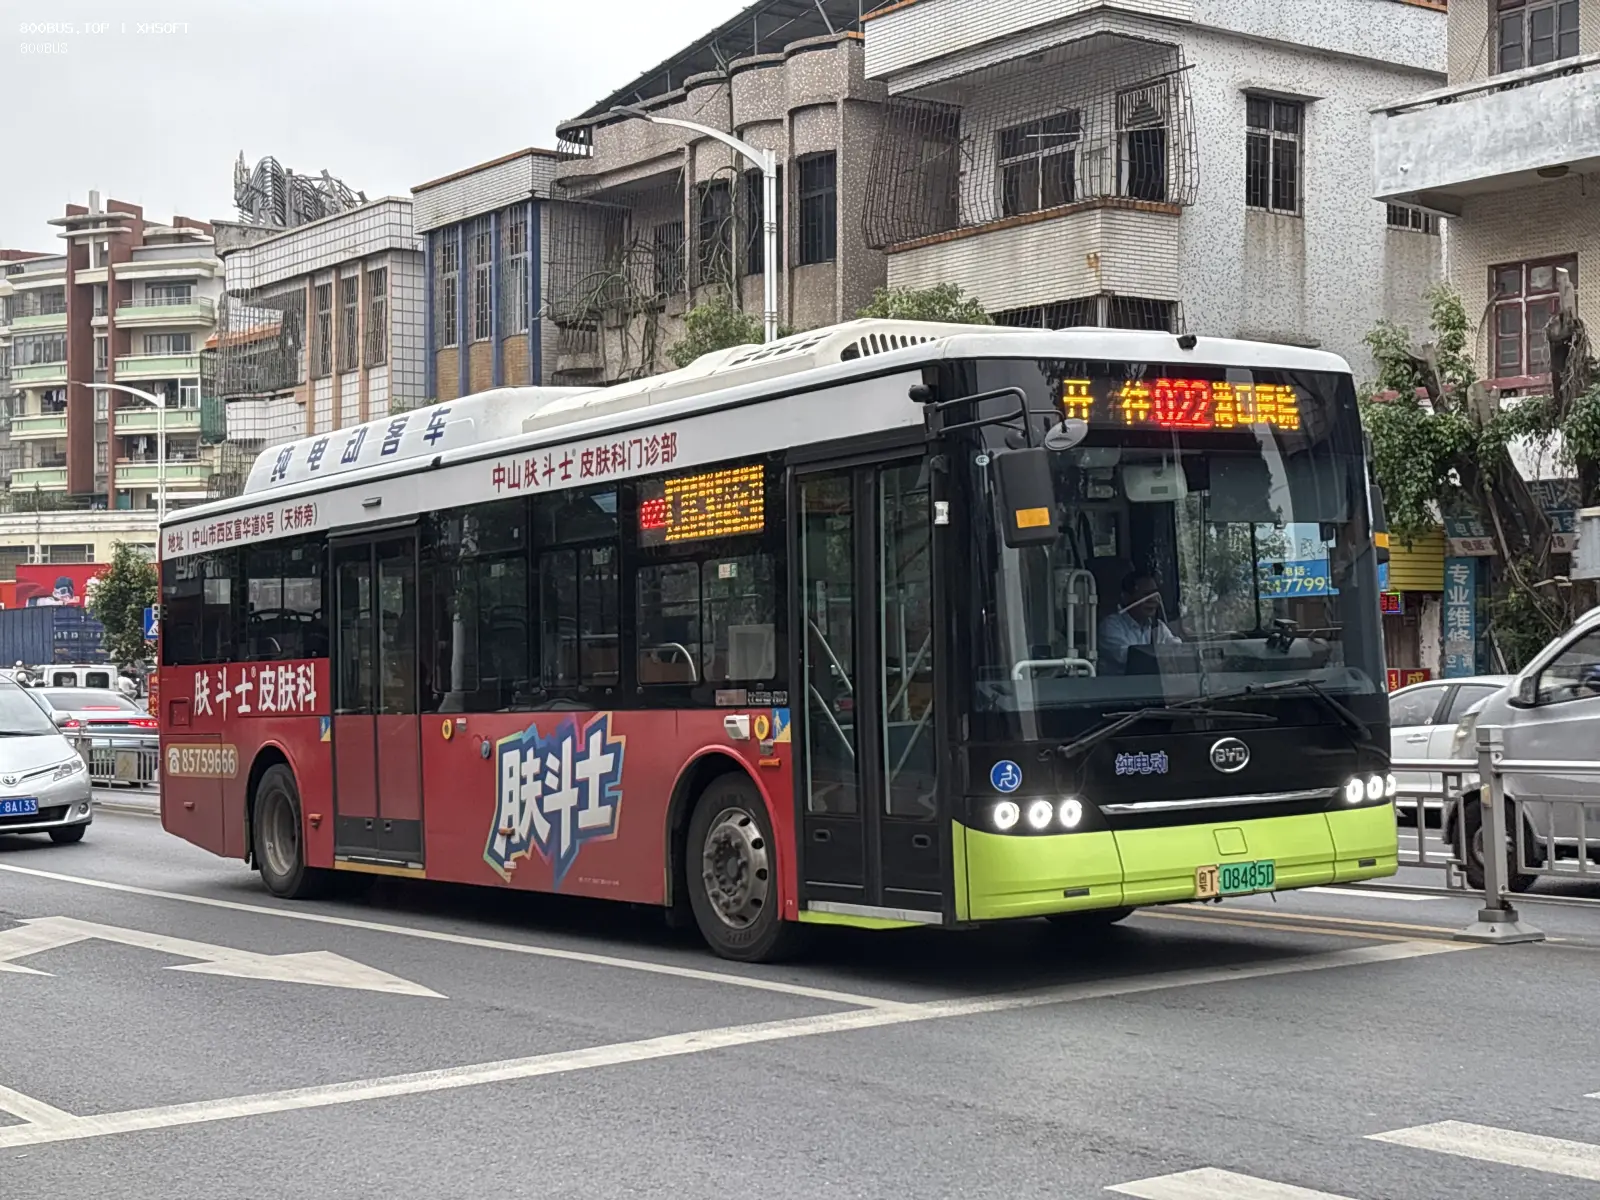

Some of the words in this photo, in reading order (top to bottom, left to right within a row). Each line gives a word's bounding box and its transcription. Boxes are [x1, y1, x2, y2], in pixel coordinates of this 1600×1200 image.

[270, 406, 452, 483] 纯电动客车
[1446, 563, 1472, 643] 专业维修
[182, 749, 236, 774] 85759666
[1114, 750, 1169, 776] 纯电动
[1214, 746, 1246, 763] BYD
[493, 729, 615, 859] 肤斗士
